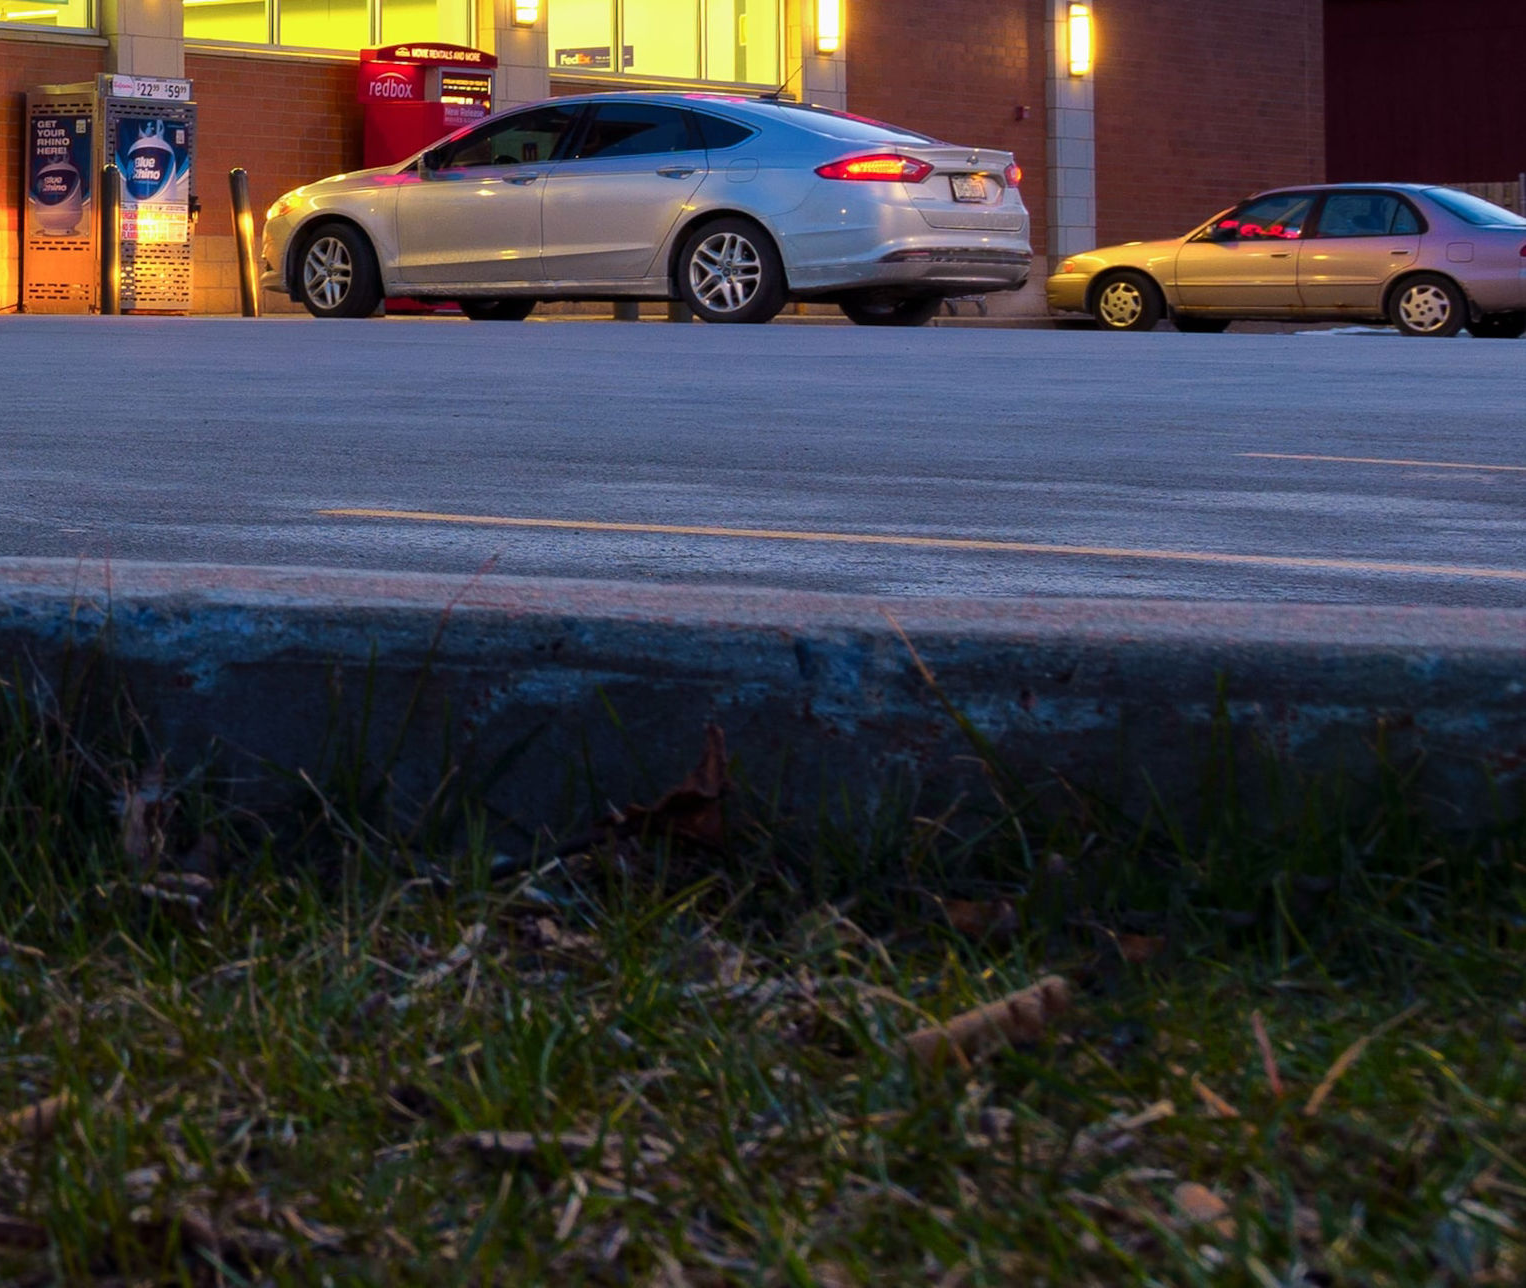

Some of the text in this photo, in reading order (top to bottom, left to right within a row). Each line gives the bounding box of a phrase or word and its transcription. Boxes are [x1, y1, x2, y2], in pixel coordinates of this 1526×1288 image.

[560, 53, 593, 65] FedEx
[369, 79, 413, 99] redbox
[37, 120, 57, 129] GET
[37, 129, 65, 138] YOUR
[37, 138, 70, 147] RHINO
[37, 146, 67, 155] HERE!
